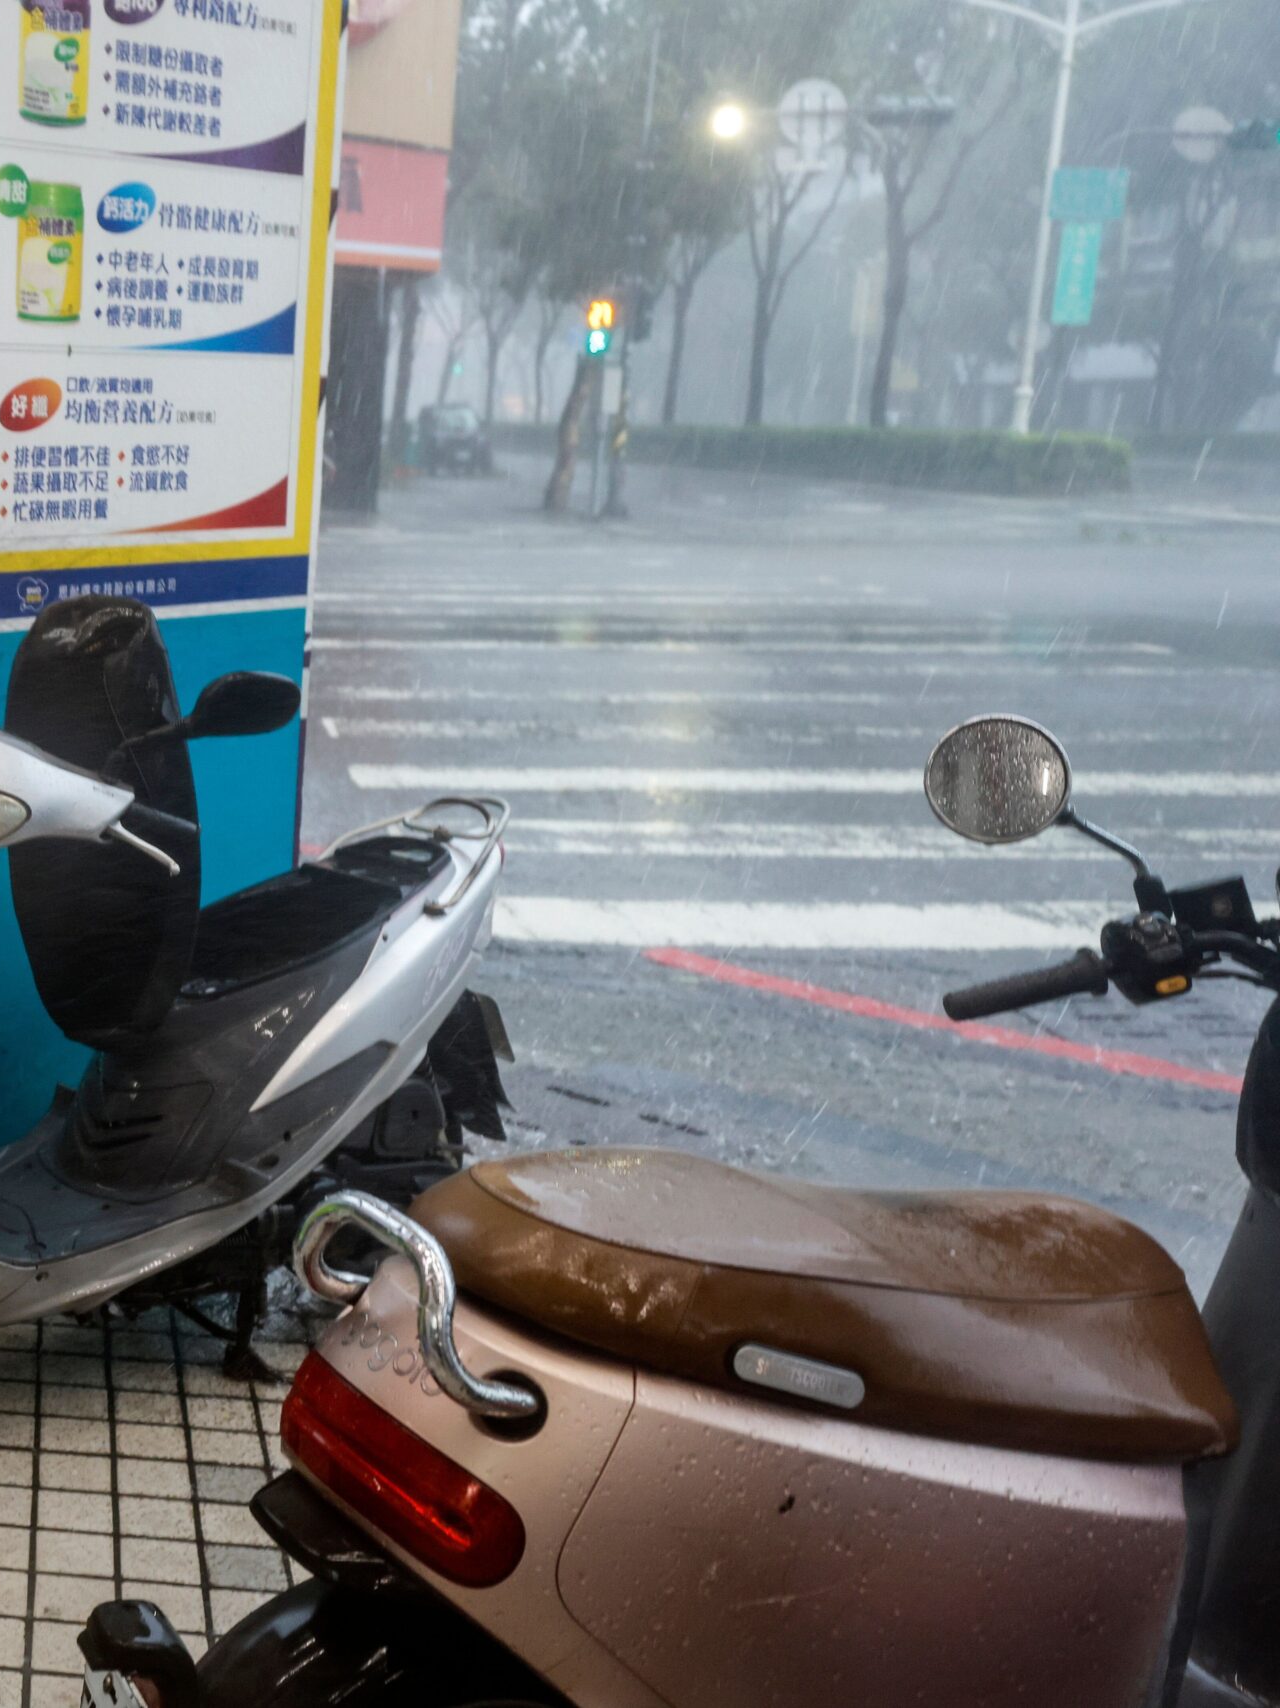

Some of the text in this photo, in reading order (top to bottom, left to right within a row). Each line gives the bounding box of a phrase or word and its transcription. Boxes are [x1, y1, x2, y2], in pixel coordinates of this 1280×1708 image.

[115, 103, 221, 138] 新陳代謝較差者
[103, 195, 149, 222] 鈣活力
[159, 202, 260, 237] 骨骼健康配方
[108, 250, 258, 280] 中老年人 成長發育期
[107, 276, 243, 304] 病後調養 運動族群
[106, 304, 182, 330] 懷孕哺乳期
[65, 399, 174, 425] 均衡營養配方
[13, 444, 190, 468] 排便習慣不佳 食慾不好
[13, 470, 188, 494] 蔬果攝取不足 流質飲食
